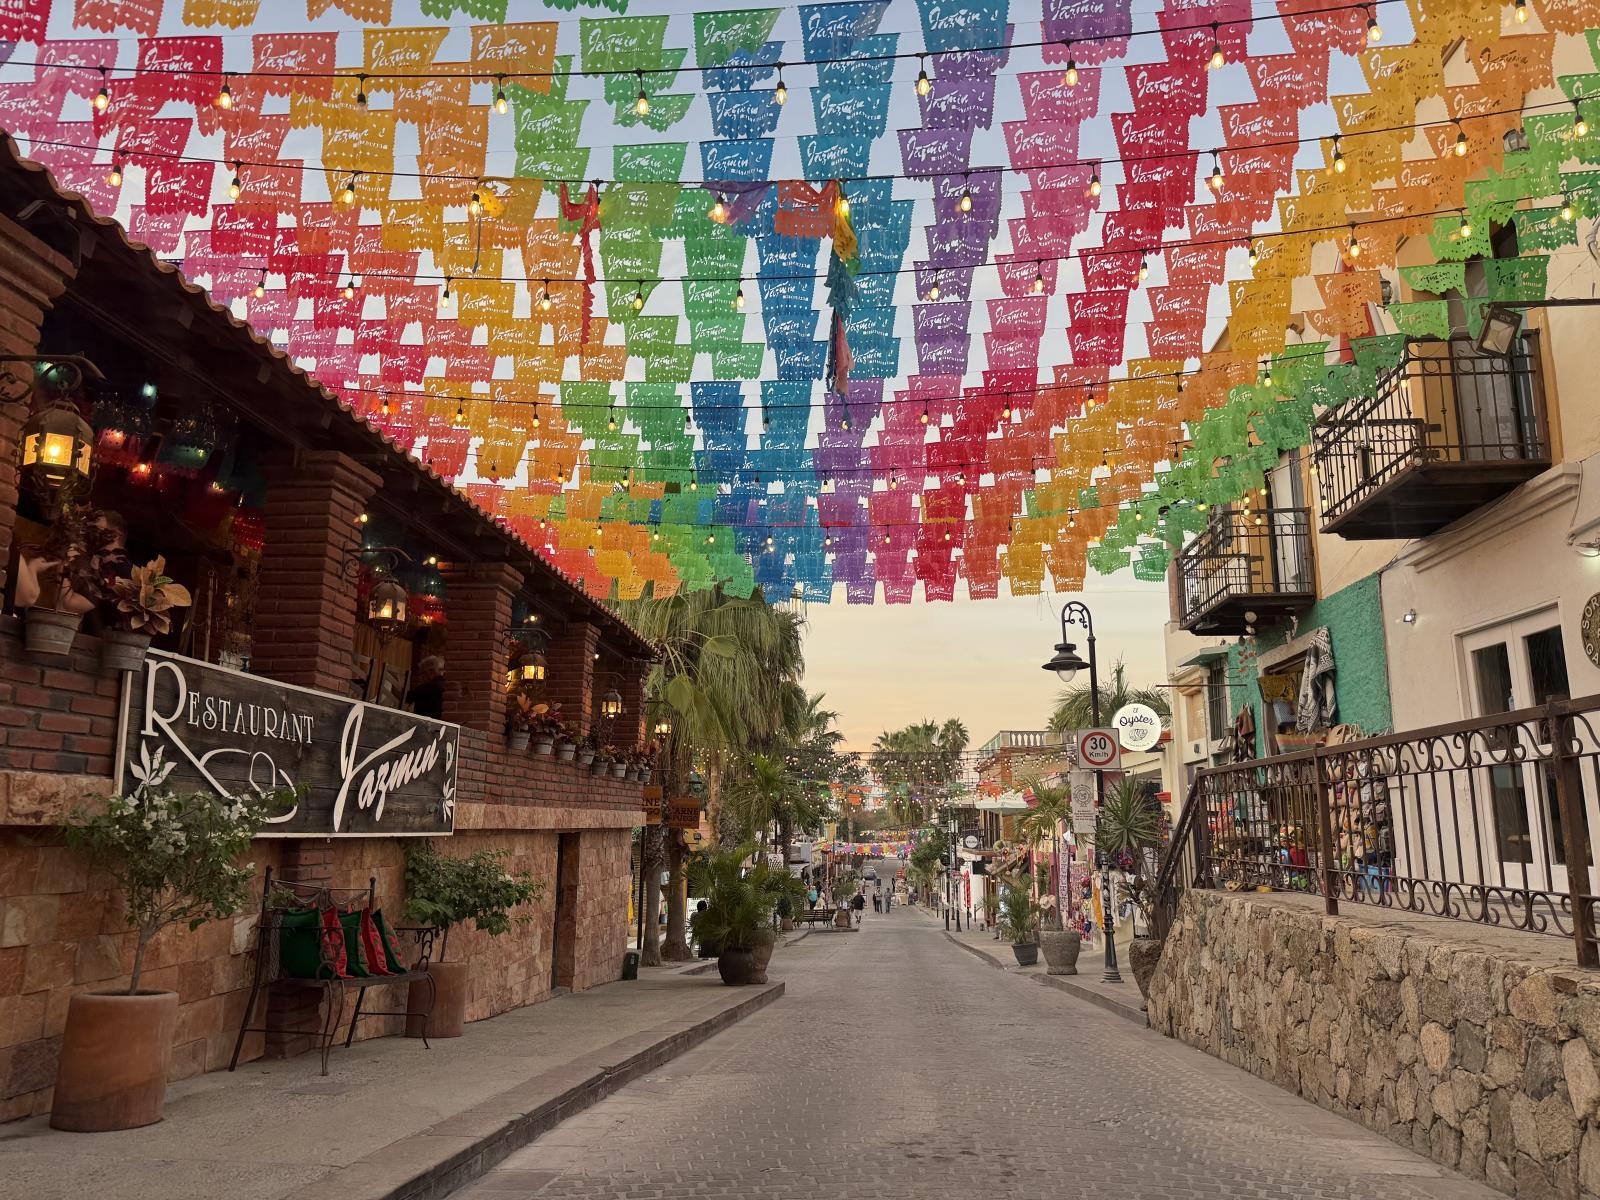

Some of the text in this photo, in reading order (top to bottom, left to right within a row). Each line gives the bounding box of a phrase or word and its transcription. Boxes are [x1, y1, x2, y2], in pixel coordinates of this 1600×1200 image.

[1119, 714, 1155, 728] Oyster
[141, 658, 315, 799] RESTAURANT
[1090, 737, 1107, 751] 30
